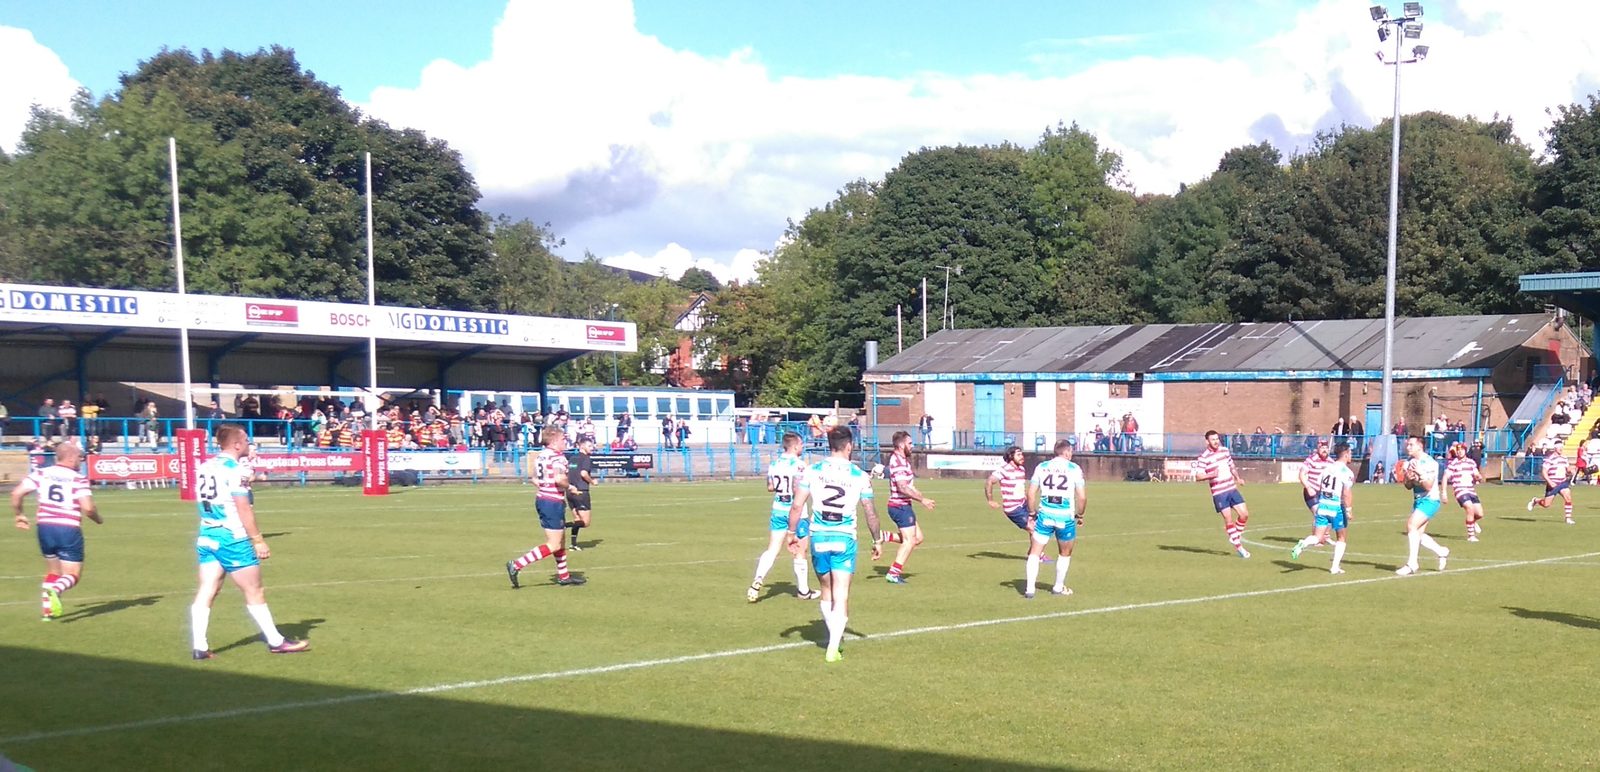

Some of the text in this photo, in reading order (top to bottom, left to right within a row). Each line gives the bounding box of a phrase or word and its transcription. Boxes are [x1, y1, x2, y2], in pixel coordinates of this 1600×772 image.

[12, 291, 137, 314] DOMESTIC
[330, 313, 371, 328] BOSCH
[414, 315, 508, 334] DOMESTIC
[299, 456, 326, 467] Press
[327, 456, 352, 466] Cider
[377, 441, 386, 485] PROPER CIDER
[198, 474, 218, 500] 23
[1042, 474, 1068, 491] 42
[1322, 474, 1337, 490] 41
[48, 484, 65, 503] 6
[821, 484, 846, 509] 2
